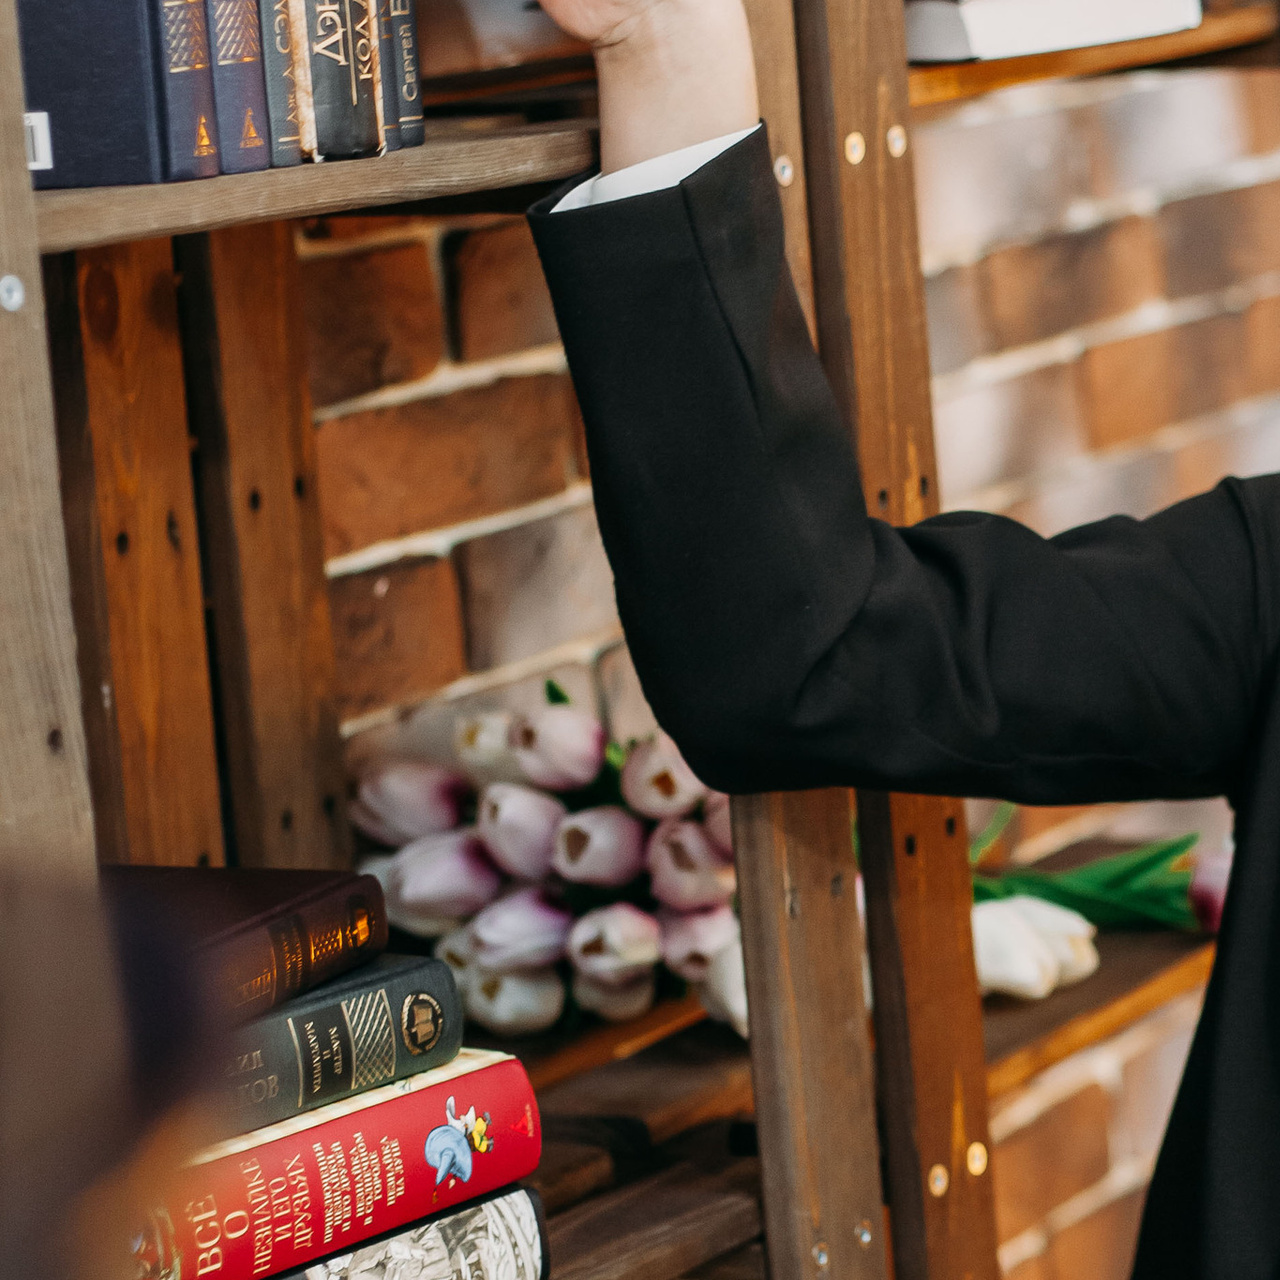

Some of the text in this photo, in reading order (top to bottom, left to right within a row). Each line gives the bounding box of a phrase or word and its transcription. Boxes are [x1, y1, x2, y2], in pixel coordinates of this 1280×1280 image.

[352, 23, 373, 81] КОД
[304, 1021, 322, 1094] МАРГАРИТА
[328, 1026, 343, 1074] МАСТЕР
[283, 1153, 314, 1250] ДРУЗЬЯХ
[312, 1142, 333, 1244] ПРИКЛЮЧЕНИЯ
[326, 1154, 343, 1227] НЕЗНАЙКИ
[330, 1141, 352, 1233] И ЕГО ДРУЗЕЙ
[349, 1147, 365, 1218] НЕЗНАЙКА
[353, 1131, 374, 1226] В СОЛНЕЧНОМ
[368, 1150, 383, 1202] ГОРОДЕ
[379, 1135, 396, 1207] НЕЗНАЙКА
[390, 1138, 405, 1197] НА ЛУНЕ
[185, 1194, 223, 1277] ВСЁ
[223, 1210, 250, 1240] О
[239, 1157, 274, 1275] НЕЗНАЙКЕ
[268, 1176, 293, 1243] И ЕГО
